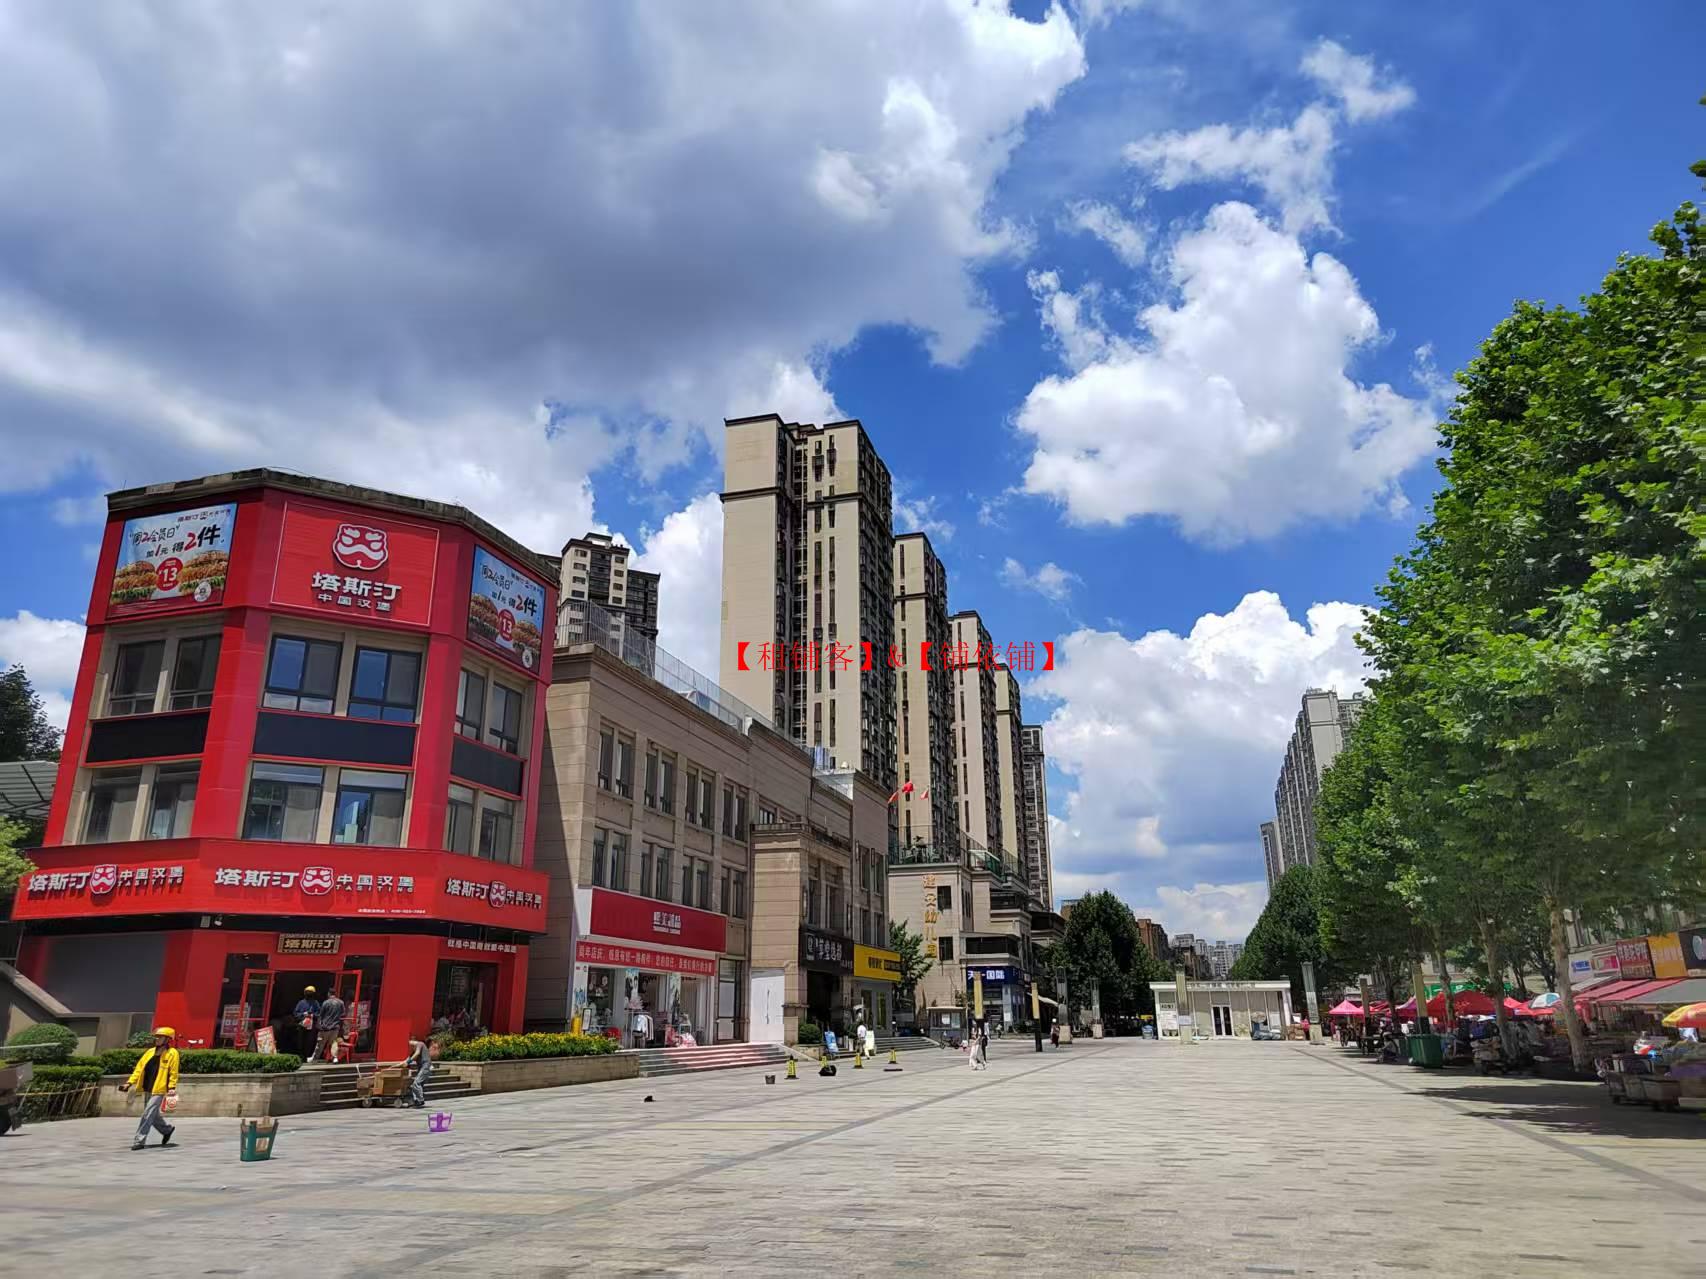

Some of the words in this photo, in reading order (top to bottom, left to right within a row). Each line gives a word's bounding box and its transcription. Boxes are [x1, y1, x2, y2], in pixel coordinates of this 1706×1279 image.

[311, 571, 402, 600] 塔斯汀
[317, 592, 391, 612] 中国汉堡
[28, 871, 91, 891] 塔斯汀
[120, 866, 183, 880] 中国汉堡
[214, 867, 299, 888] 塔斯汀
[336, 874, 414, 887] 中国汉堡
[446, 878, 490, 899] 塔斯汀
[284, 938, 334, 950] 塔斯汀
